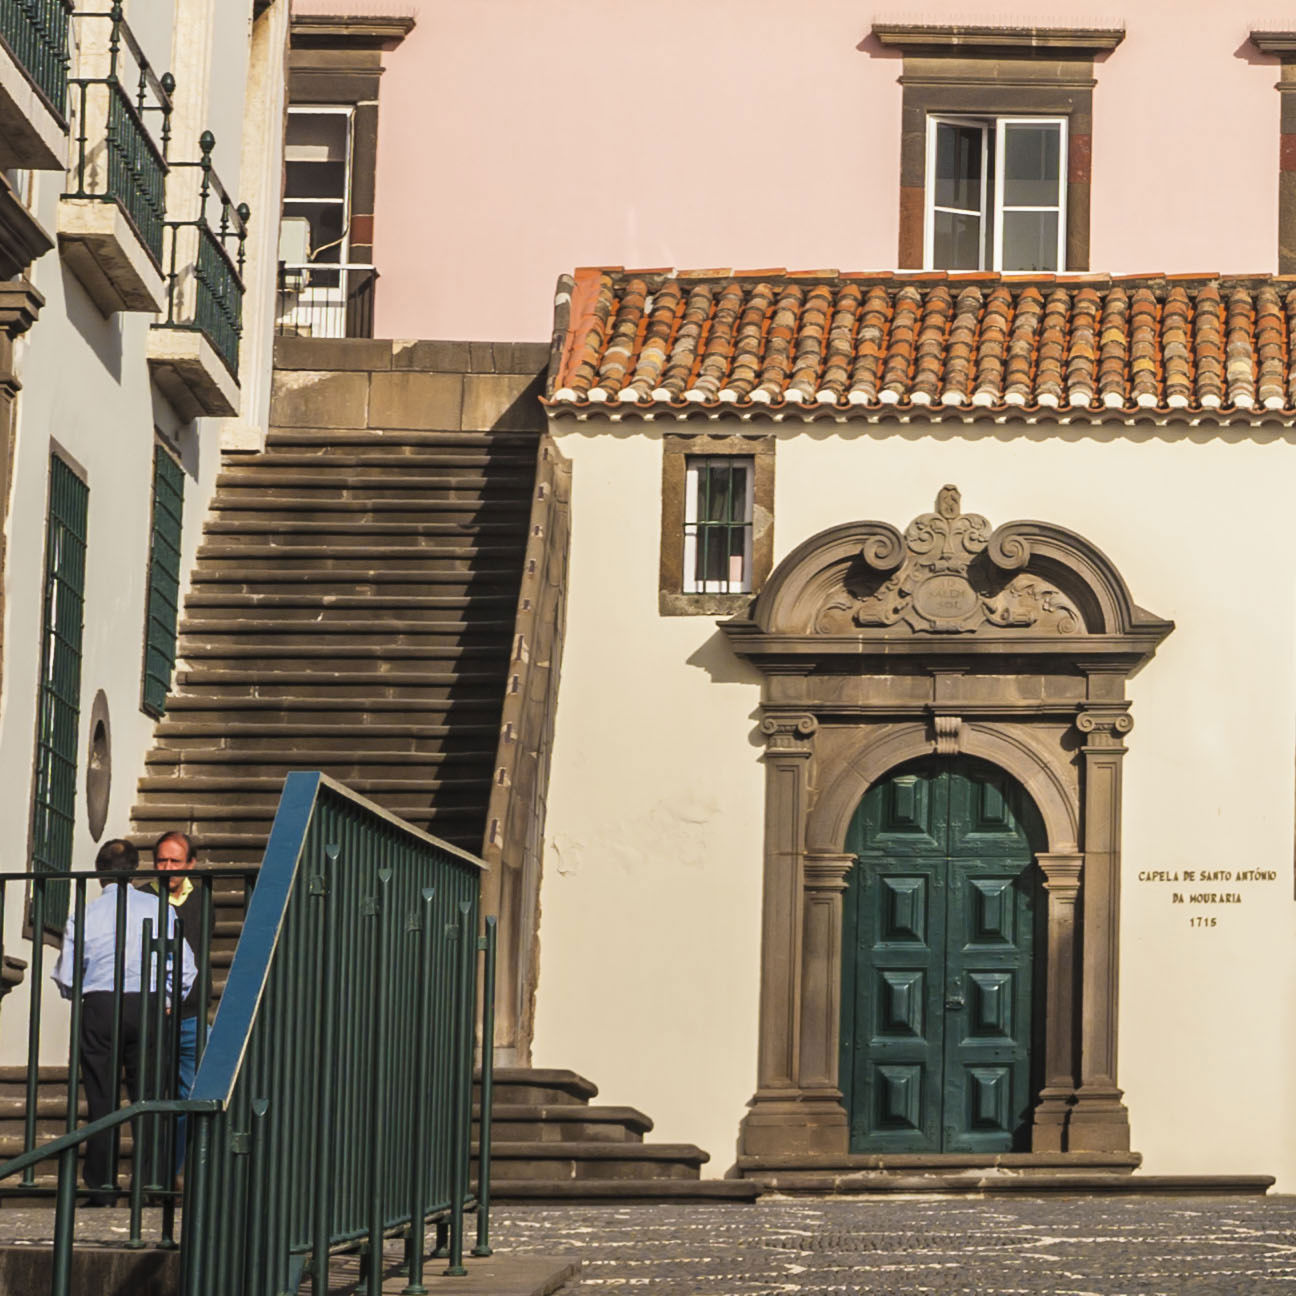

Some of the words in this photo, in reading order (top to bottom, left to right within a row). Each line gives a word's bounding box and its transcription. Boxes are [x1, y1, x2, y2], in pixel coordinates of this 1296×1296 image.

[1138, 871, 1179, 882] CAPELA
[1184, 871, 1195, 882] DE
[1200, 871, 1231, 882] SANTO
[1235, 867, 1276, 882] ANTÓNIO
[1172, 893, 1184, 904] DA
[1189, 893, 1241, 904] MOURARIA
[1190, 917, 1216, 927] 1715
